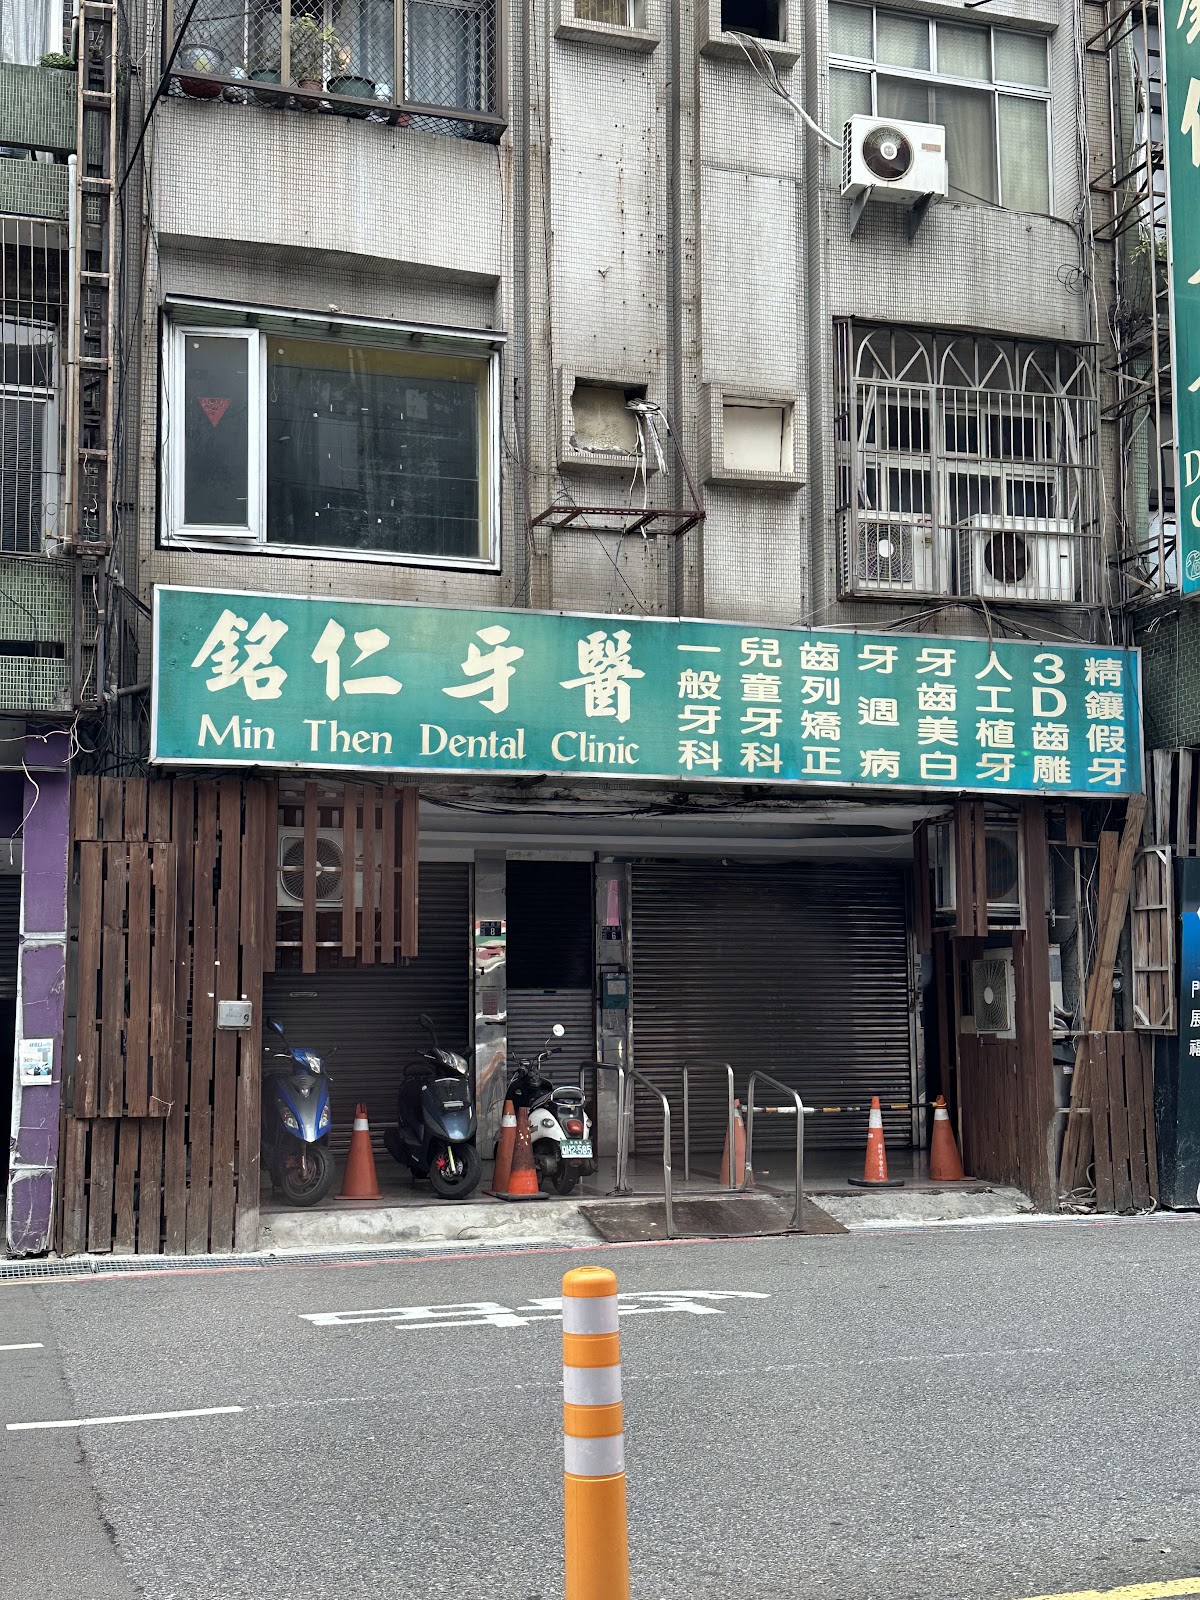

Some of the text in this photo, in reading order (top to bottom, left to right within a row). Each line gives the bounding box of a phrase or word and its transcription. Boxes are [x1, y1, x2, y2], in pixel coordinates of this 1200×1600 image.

[191, 608, 646, 724] 銘仁牙醫
[677, 644, 723, 772] 一般牙科
[738, 636, 783, 774] 兒童牙科
[799, 640, 842, 776] 齒列矯正
[857, 643, 900, 780] 牙週病
[915, 647, 959, 781] 牙齒美白
[975, 650, 1016, 783] 人工植牙
[1031, 653, 1072, 785] 3D齒雕
[1083, 657, 1127, 786] 精鑲假牙
[198, 713, 640, 764] Min Then Dental Clinic
